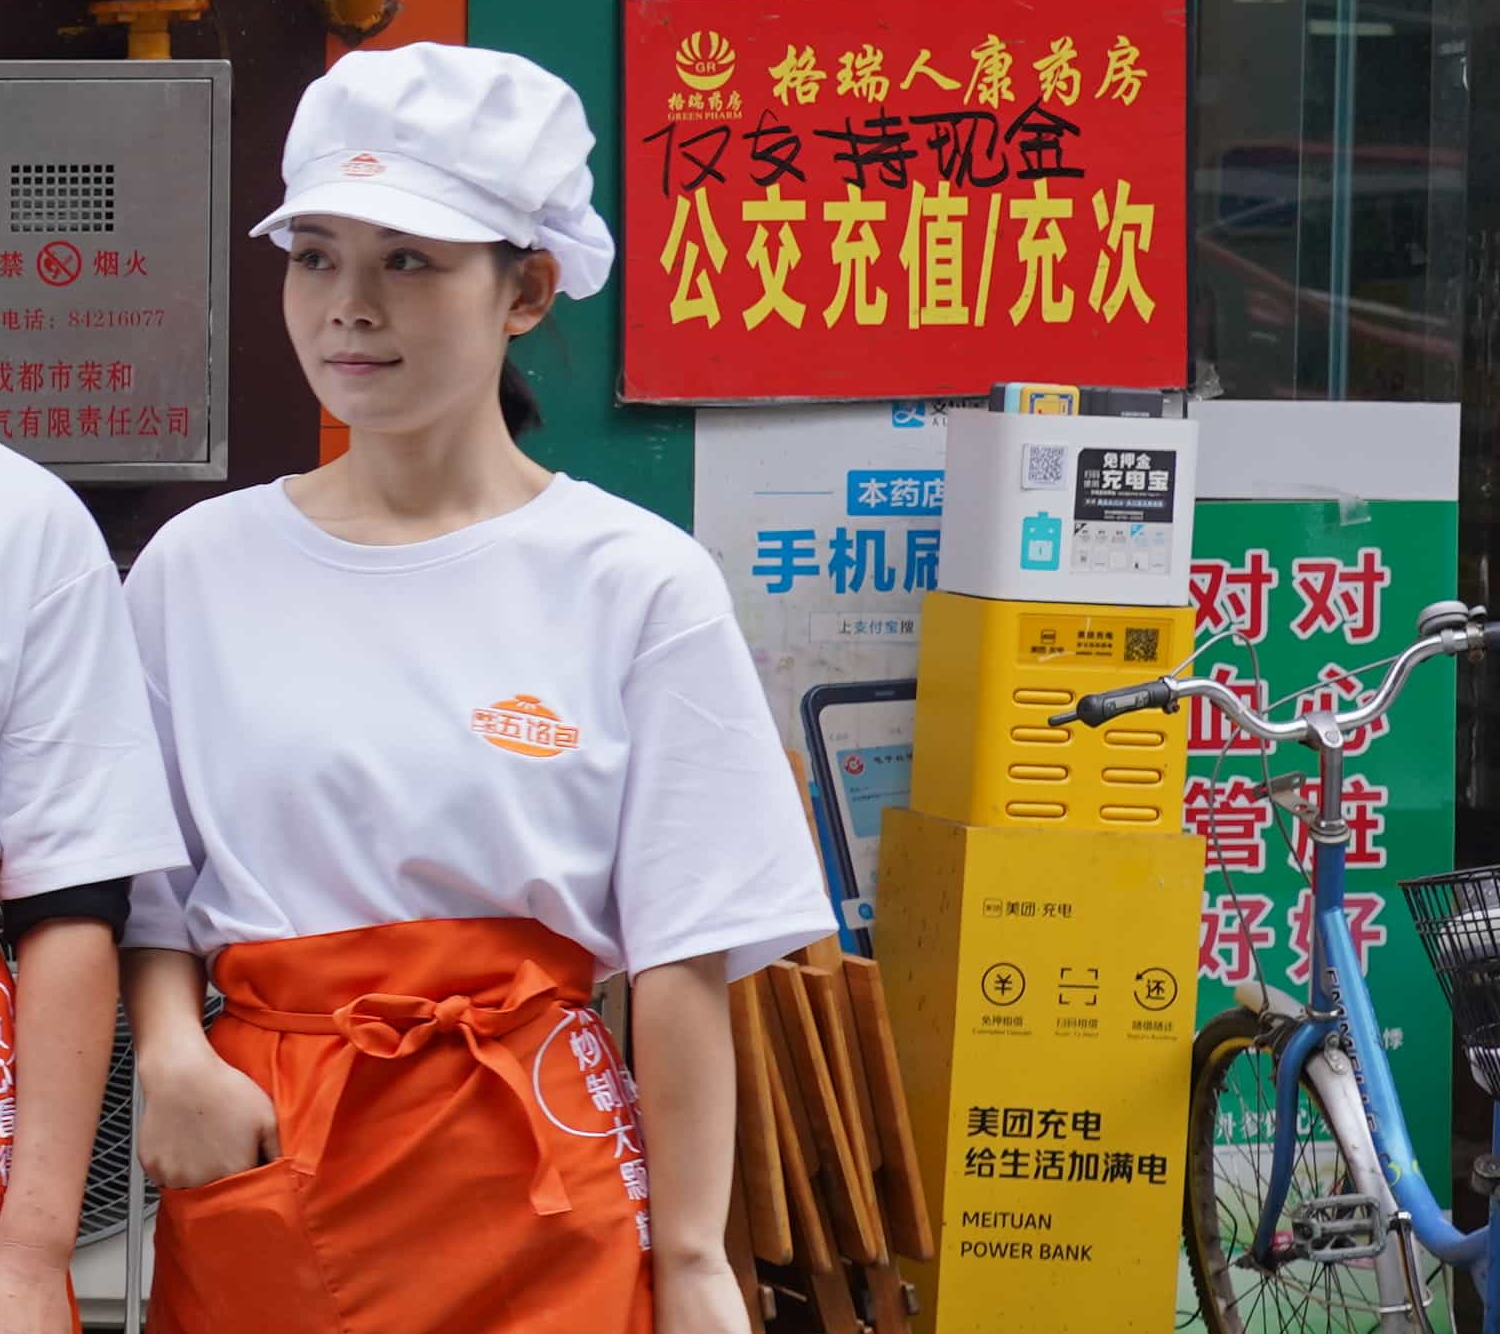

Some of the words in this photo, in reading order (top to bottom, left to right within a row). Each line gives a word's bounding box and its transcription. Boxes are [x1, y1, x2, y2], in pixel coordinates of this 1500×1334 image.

[769, 33, 1149, 110] 格瑞人康药房
[668, 91, 742, 113] 格瑞药房
[668, 111, 702, 121] GREEN
[704, 111, 743, 121] PHARM
[92, 250, 148, 278] 烟火
[660, 178, 1156, 329] 公交充值/充次
[67, 309, 165, 328] 84216077
[1101, 470, 1169, 492] 充电宝
[967, 1106, 1102, 1142] 美团充电
[965, 1147, 1168, 1185] 给生活加满电
[962, 1211, 1052, 1231] MEITUAN
[960, 1240, 1033, 1261] POWER
[1039, 1242, 1092, 1262] BANK
